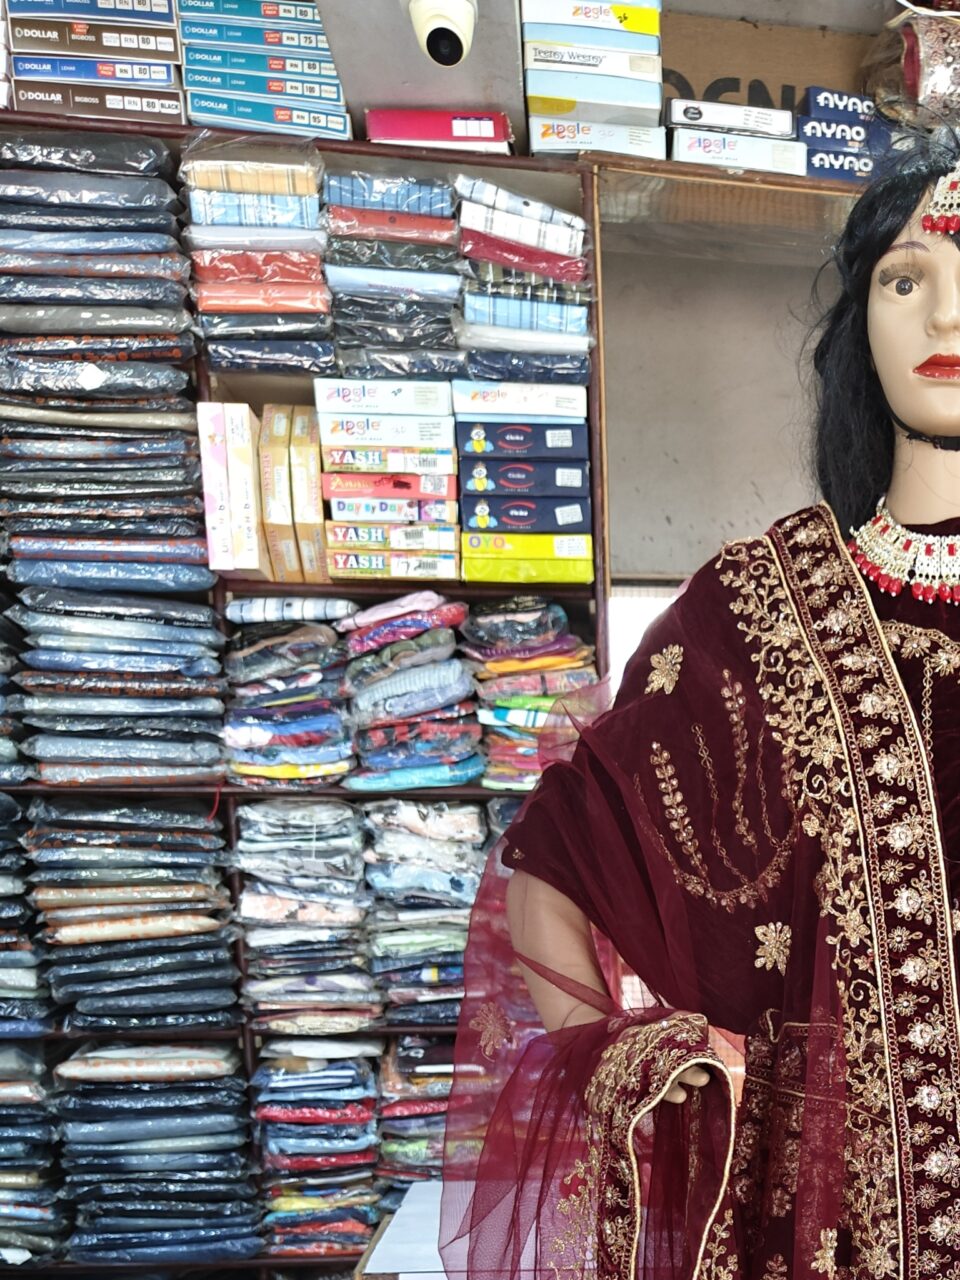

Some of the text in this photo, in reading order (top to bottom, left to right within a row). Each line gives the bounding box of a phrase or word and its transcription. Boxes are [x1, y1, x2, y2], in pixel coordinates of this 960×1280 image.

[188, 0, 215, 8] DOLLAR
[299, 9, 309, 17] 80
[24, 28, 59, 39] DOLLAR
[141, 37, 151, 45] 80
[191, 27, 218, 35] DOLLAR
[303, 36, 313, 45] 75
[195, 53, 222, 62] DOLLAR
[24, 63, 52, 71] DOLLAR
[138, 67, 148, 75] 80
[194, 75, 221, 83] DOLLAR
[28, 91, 63, 101] DOLLAR
[146, 100, 156, 109] 80
[160, 102, 179, 110] BLACK
[200, 101, 228, 110] DOLLAR
[312, 115, 321, 124] 95
[803, 121, 866, 141] AYAO
[811, 153, 874, 171] AYAO
[330, 450, 383, 466] YASH
[337, 501, 362, 515] Day
[379, 501, 404, 514] Day
[334, 526, 385, 543] YASH
[469, 535, 506, 549] OYO
[334, 553, 386, 570] YASH
